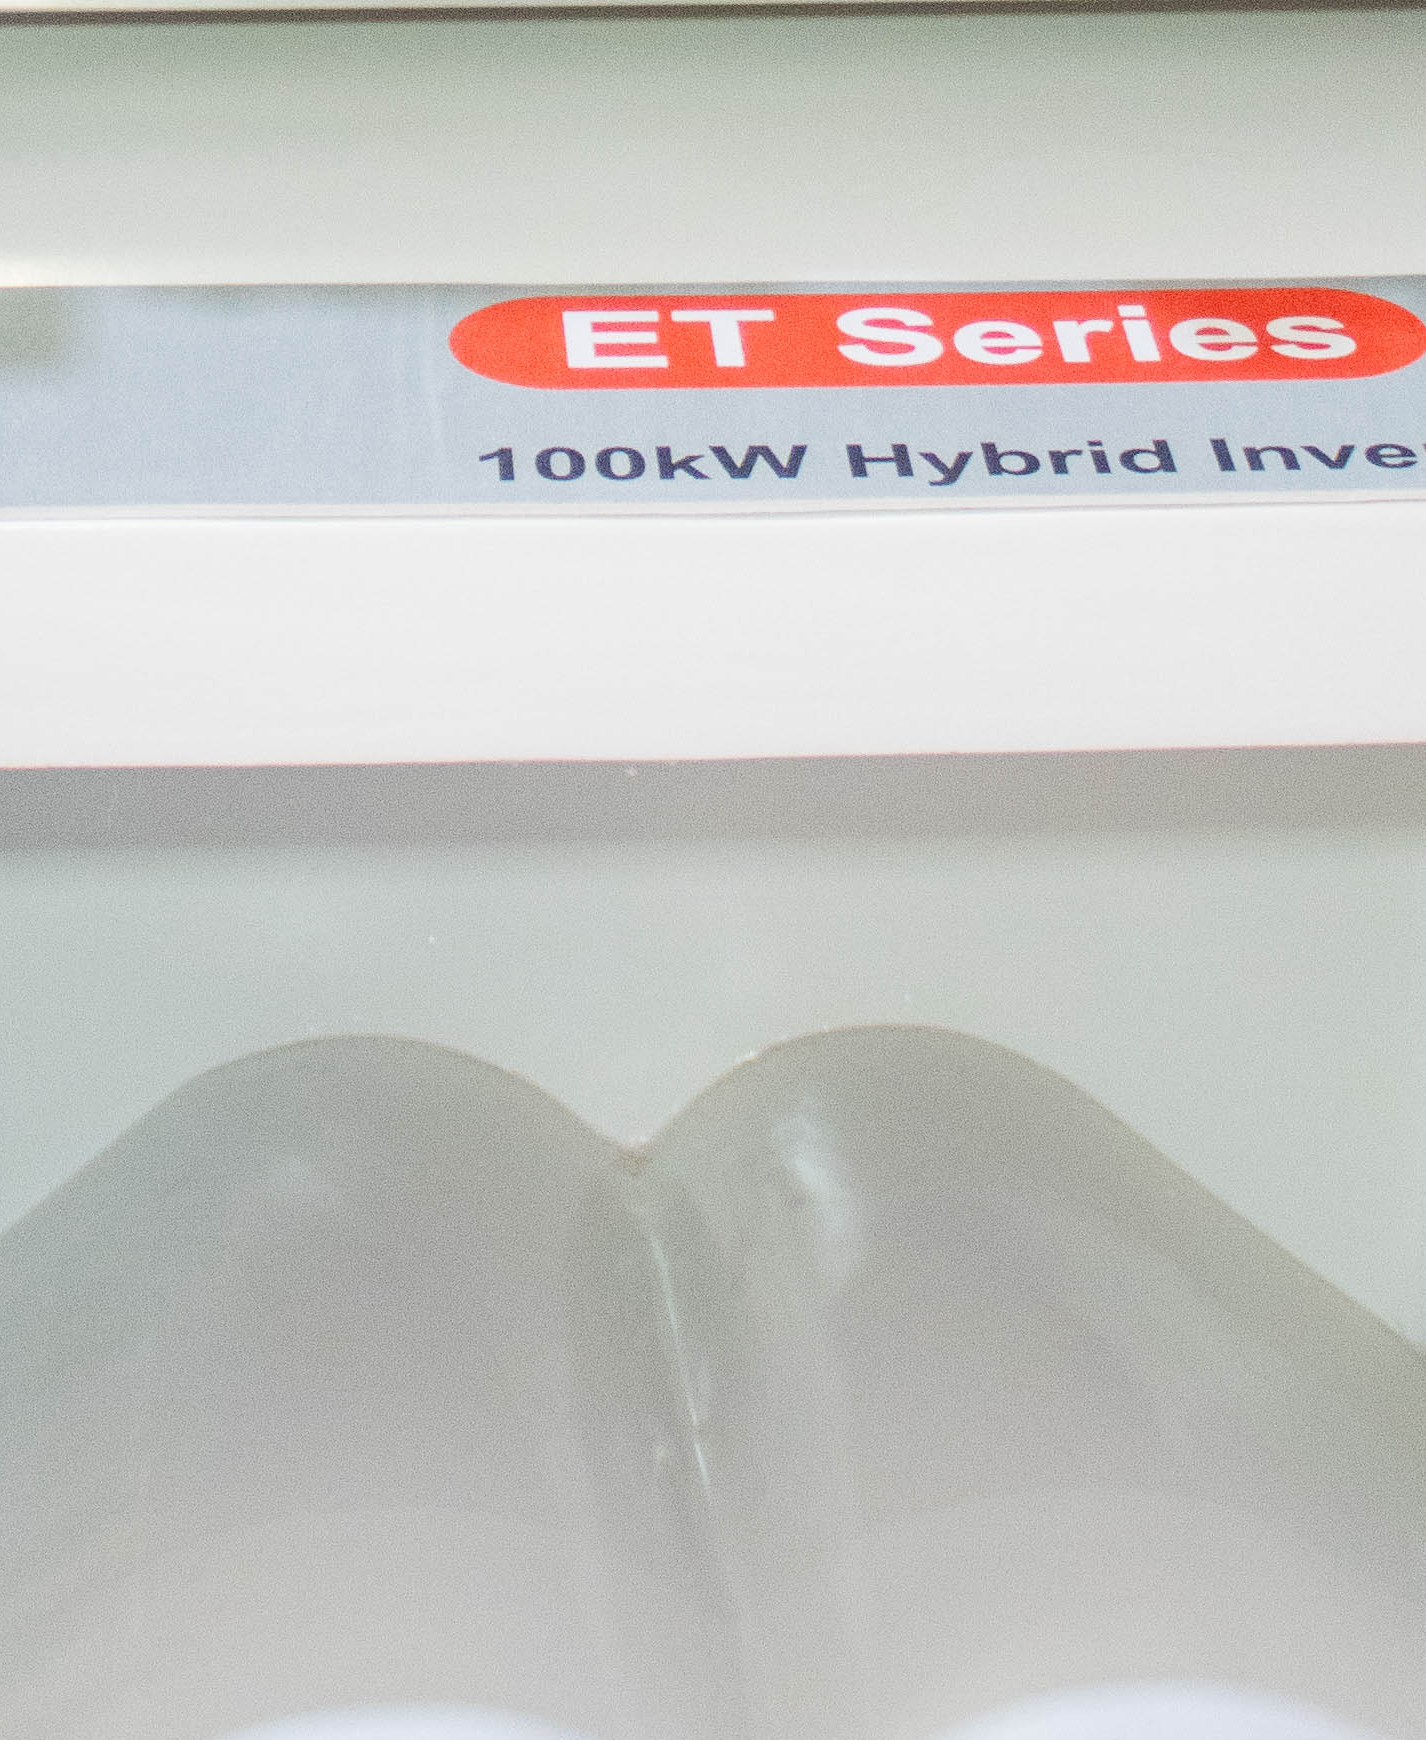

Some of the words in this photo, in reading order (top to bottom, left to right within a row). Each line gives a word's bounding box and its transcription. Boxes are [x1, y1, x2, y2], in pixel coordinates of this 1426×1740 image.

[562, 308, 775, 369] ET
[836, 304, 1356, 368] Series
[480, 445, 807, 481] 100kW
[847, 440, 1177, 486] Hybrid
